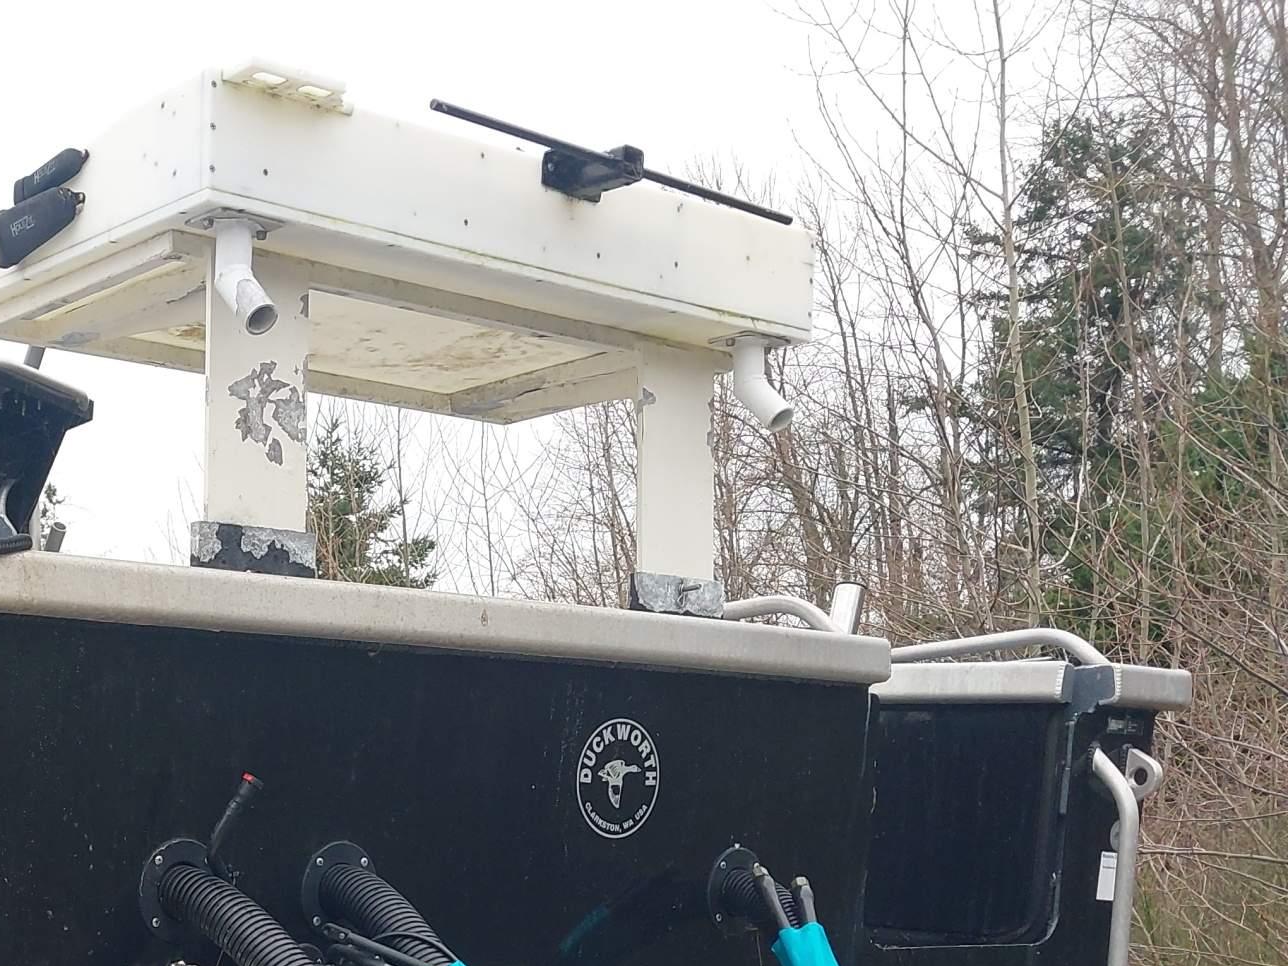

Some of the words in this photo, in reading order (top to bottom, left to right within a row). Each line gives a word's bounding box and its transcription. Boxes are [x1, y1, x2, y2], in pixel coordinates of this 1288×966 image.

[580, 724, 657, 786] DUCKWORTH
[585, 802, 622, 832] CLARKSTON,
[622, 819, 634, 829] WA
[634, 804, 648, 820] USA
